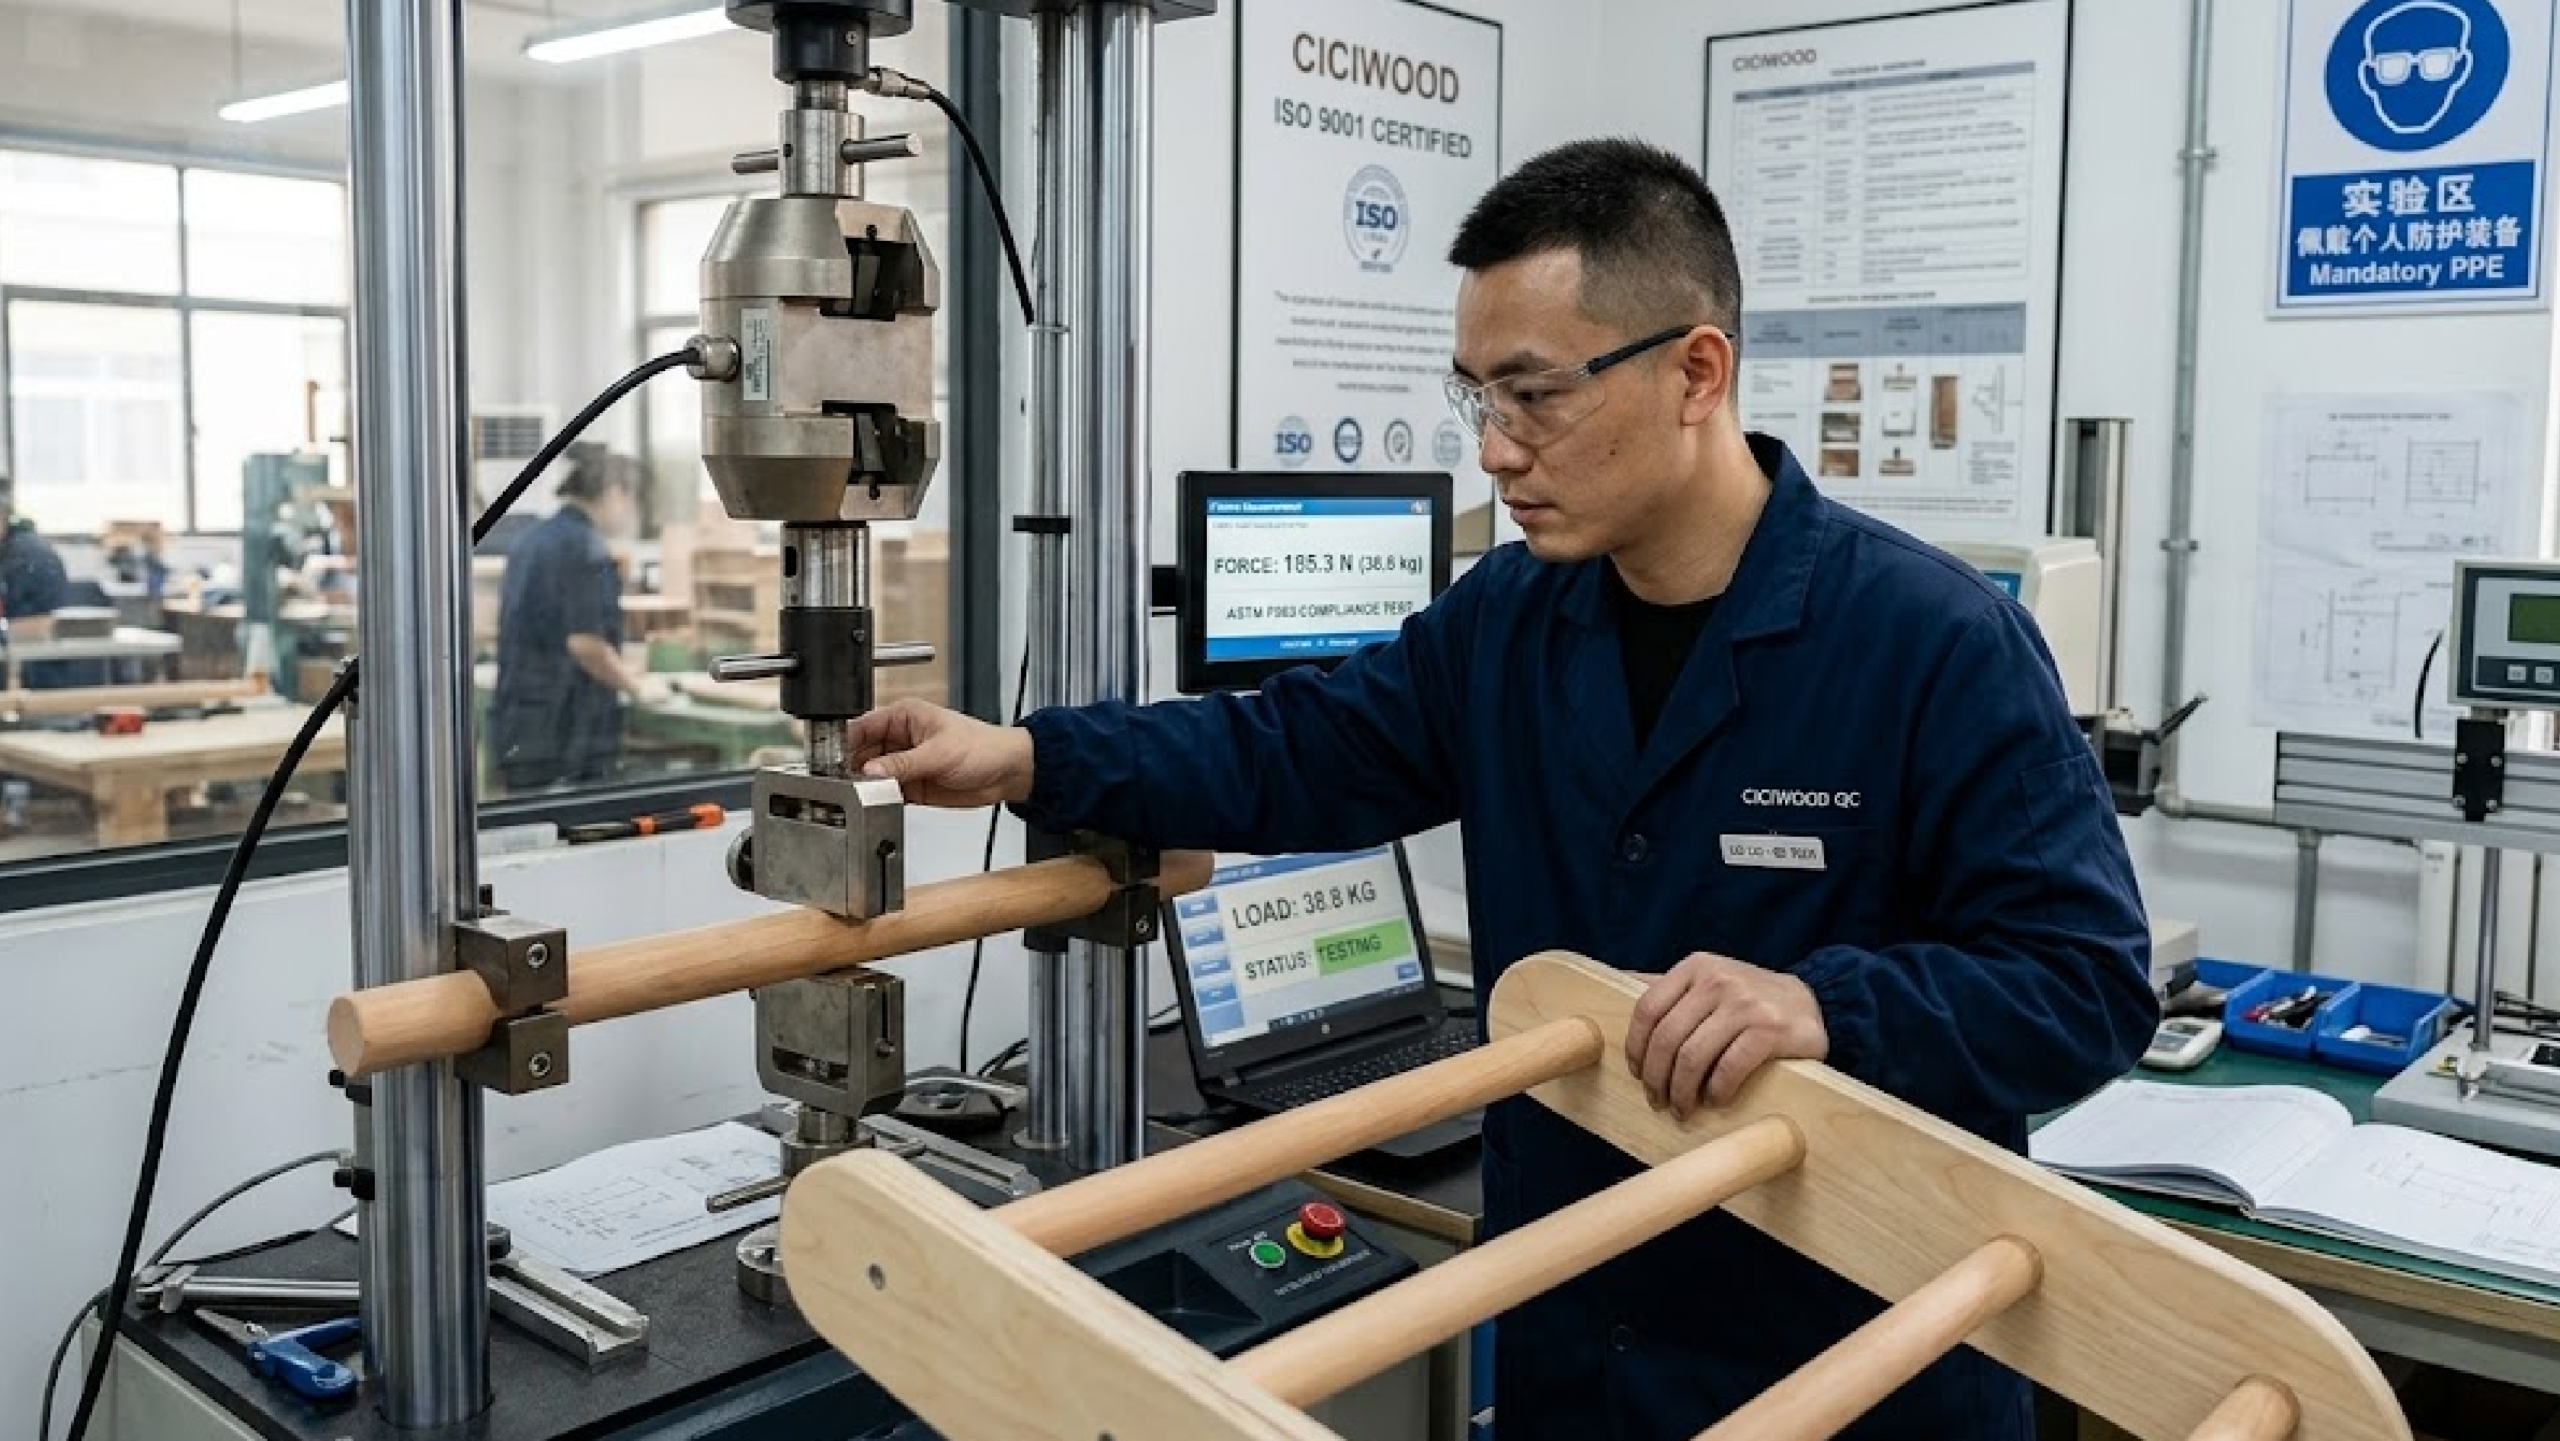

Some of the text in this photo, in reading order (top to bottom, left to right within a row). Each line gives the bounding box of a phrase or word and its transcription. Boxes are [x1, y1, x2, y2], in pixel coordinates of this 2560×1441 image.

[1292, 31, 1460, 104] CICIWOOD
[1274, 97, 1473, 159] ISO 9001 CERTIFIED
[2342, 174, 2477, 218] 实验区
[1355, 200, 1399, 231] ISO
[2309, 254, 2505, 288] Mandatory PPE
[1274, 432, 1313, 454] ISO
[1213, 557, 1279, 575] FORCE:
[1340, 554, 1354, 573] N
[1834, 791, 1862, 809] QC
[1231, 881, 1378, 930] LOAD: 38.8 KG
[1244, 950, 1313, 981] STATUS:
